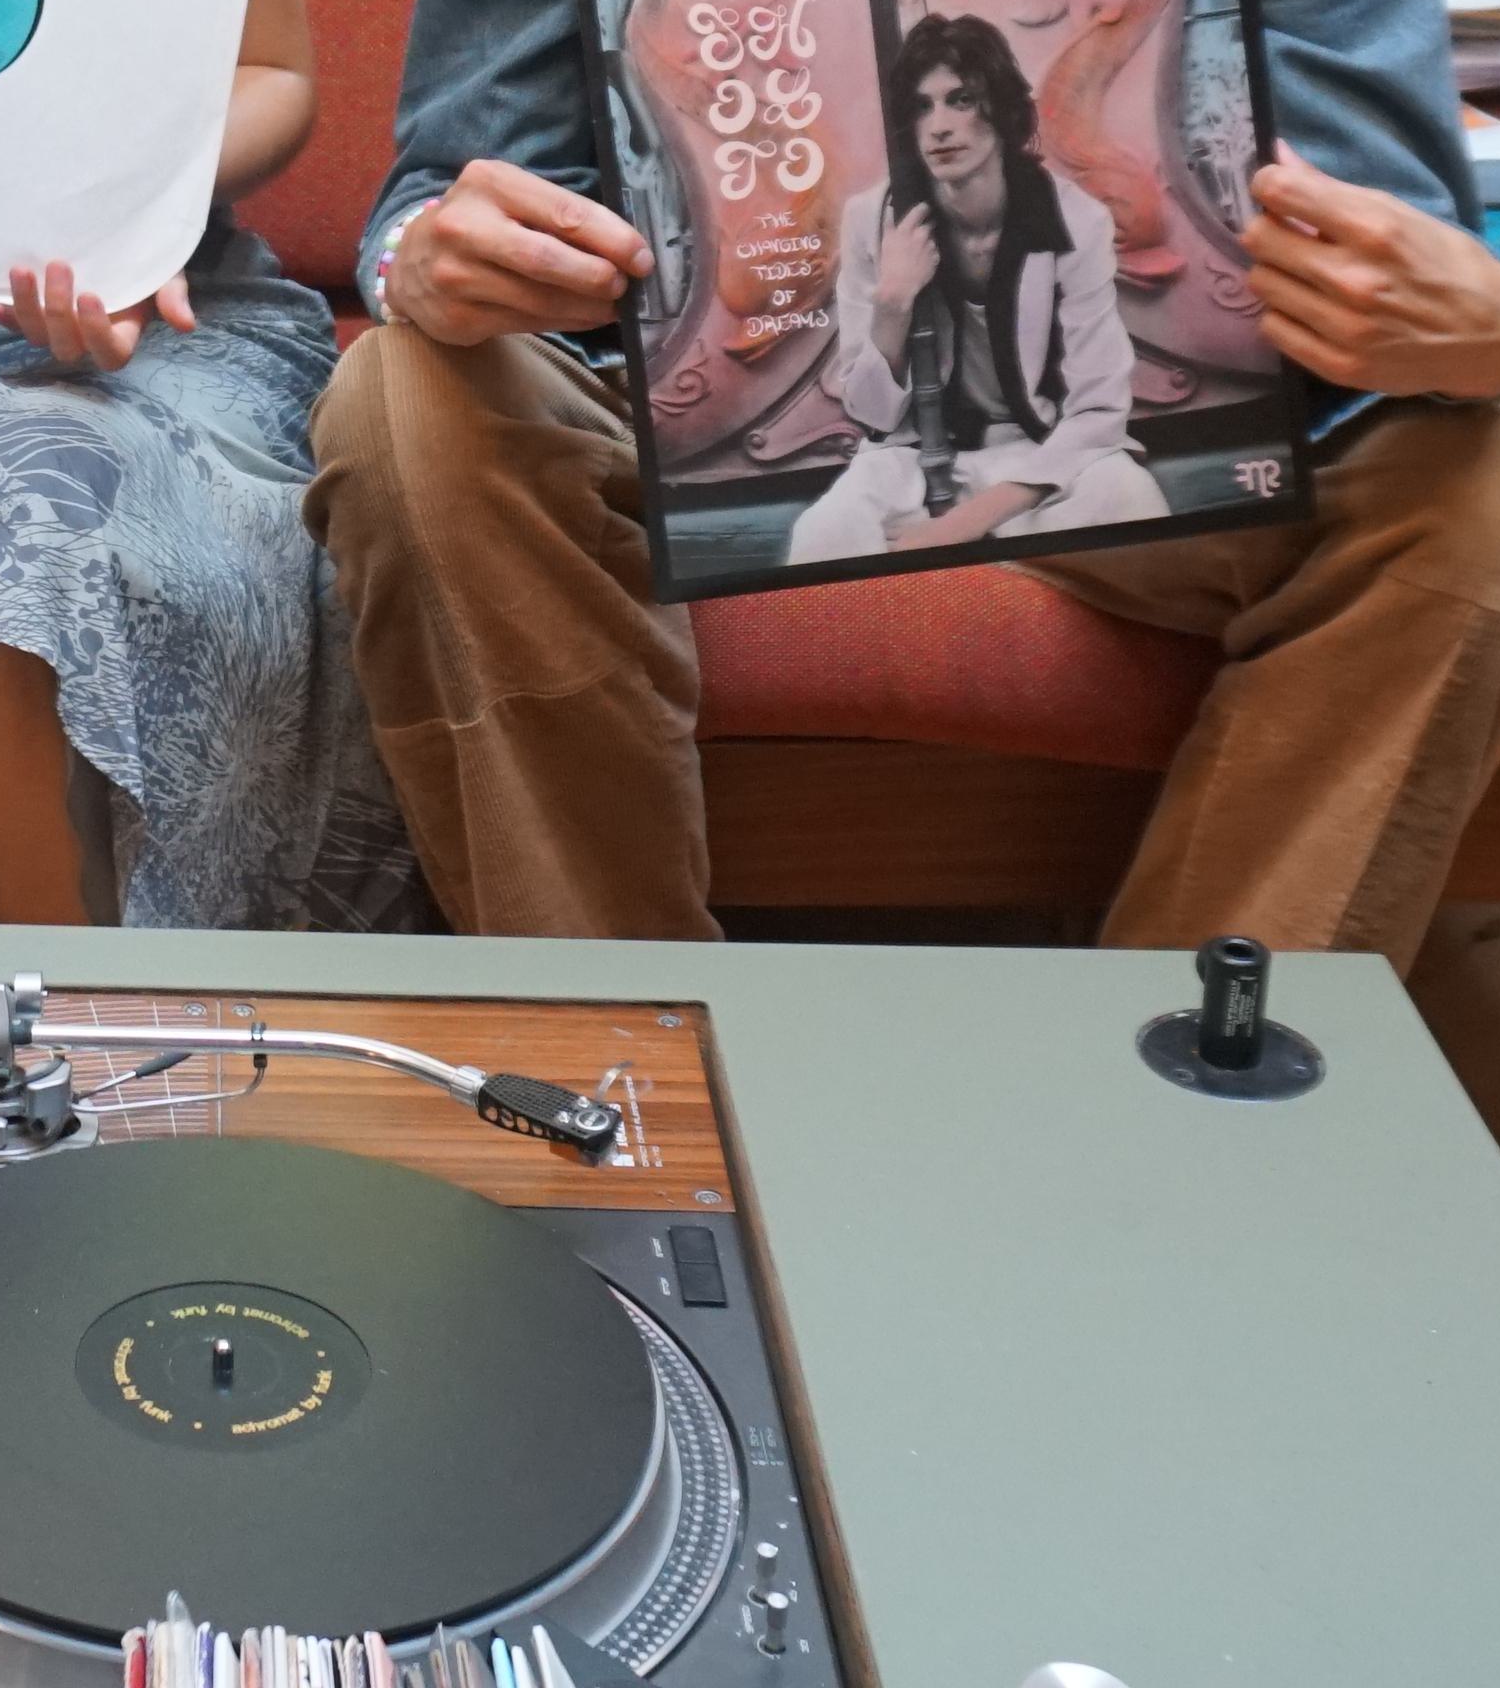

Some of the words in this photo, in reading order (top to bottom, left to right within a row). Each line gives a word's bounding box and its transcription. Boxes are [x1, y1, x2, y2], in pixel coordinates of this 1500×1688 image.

[752, 210, 798, 229] THE
[736, 233, 821, 258] CHANGING
[749, 259, 812, 280] TIDES
[772, 290, 797, 306] OF
[746, 309, 829, 337] DREAMS
[170, 1304, 208, 1320] funk
[215, 1302, 236, 1316] by
[243, 1305, 310, 1339] achromat
[139, 1400, 173, 1422] funk
[232, 1408, 305, 1434] achromat
[299, 1394, 322, 1411] by
